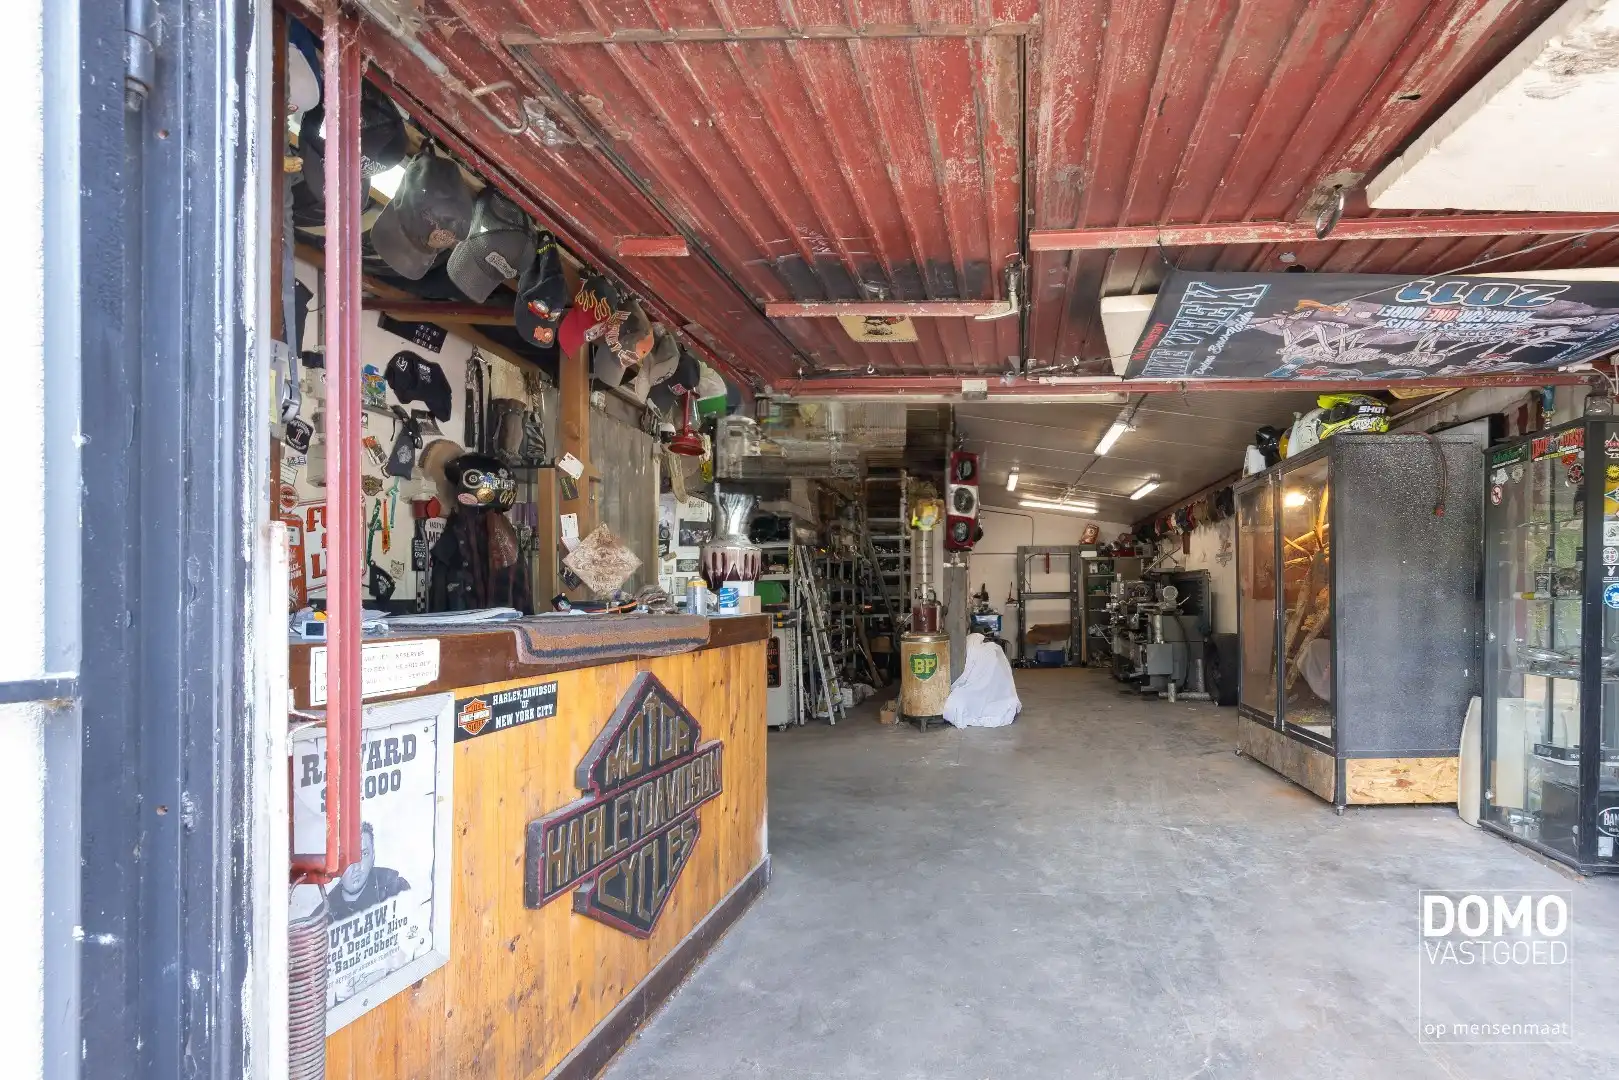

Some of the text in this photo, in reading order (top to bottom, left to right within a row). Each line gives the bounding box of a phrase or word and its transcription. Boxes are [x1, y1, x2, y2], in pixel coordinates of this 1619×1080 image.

[1395, 280, 1571, 307] 2011
[1427, 307, 1460, 321] ONE
[1358, 405, 1386, 415] SHOT
[914, 658, 937, 674] BP
[493, 683, 557, 706] HARLEY-DAVIDSON
[495, 704, 554, 729] NEW YORK CITY
[604, 691, 692, 786] MOTOR
[301, 734, 417, 788] RARD
[598, 816, 697, 922] CYCLES
[331, 905, 388, 949] UTLAW
[347, 933, 371, 955] Dead
[374, 928, 385, 940] or
[387, 916, 408, 935] Alive
[364, 933, 399, 960] robbery
